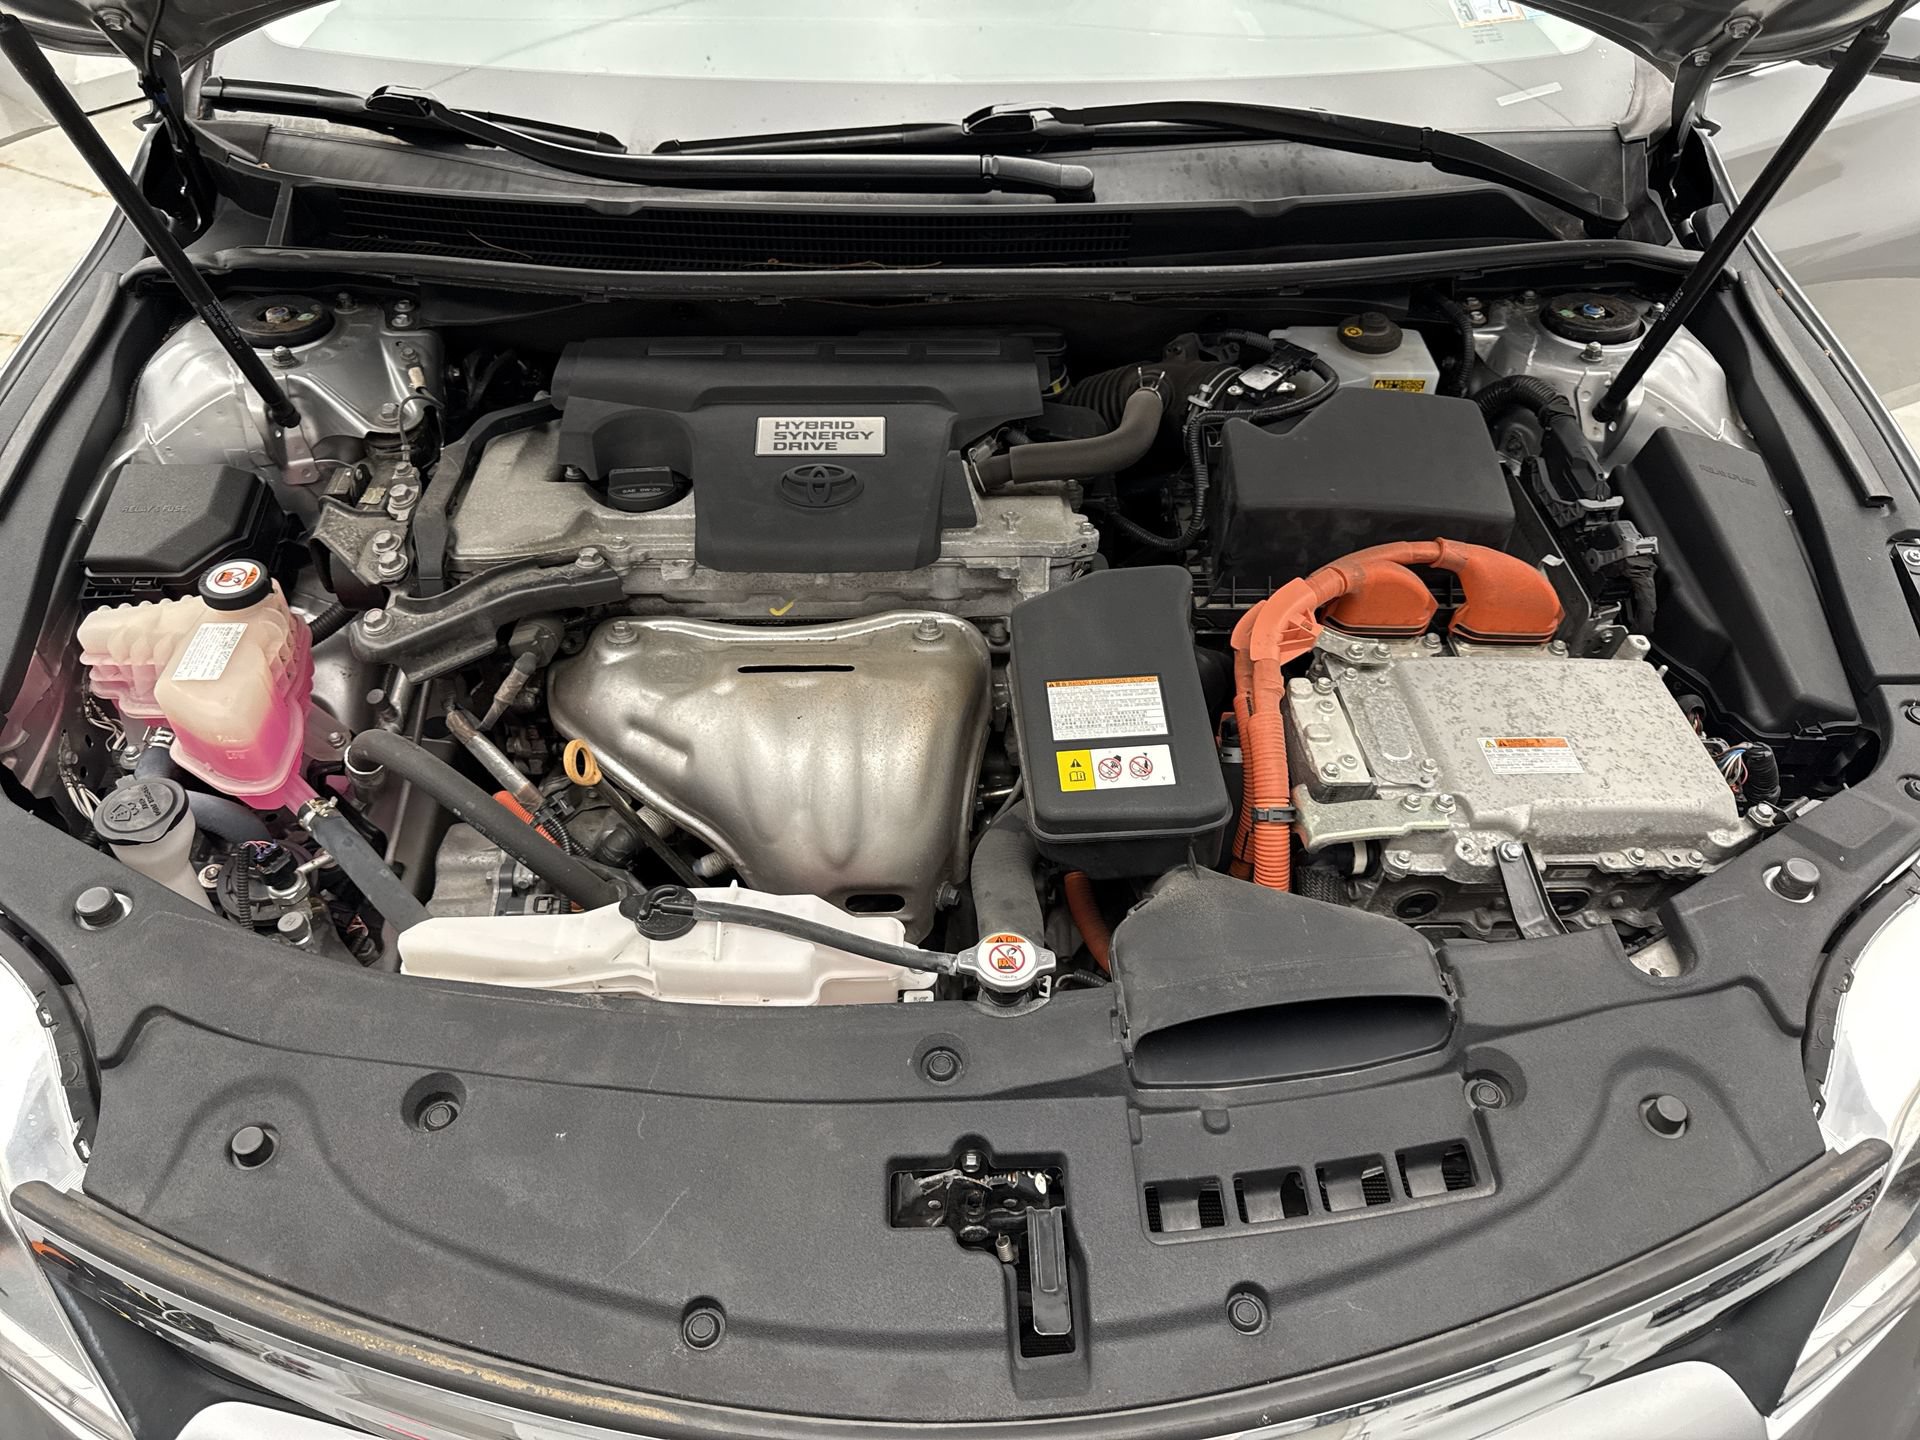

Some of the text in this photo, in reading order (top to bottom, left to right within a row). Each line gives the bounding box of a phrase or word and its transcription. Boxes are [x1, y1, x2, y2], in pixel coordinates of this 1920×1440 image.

[775, 421, 855, 430] HYBRID
[773, 431, 875, 440] SYNERGY
[773, 442, 838, 451] DRIVE
[162, 504, 187, 513] FUSE
